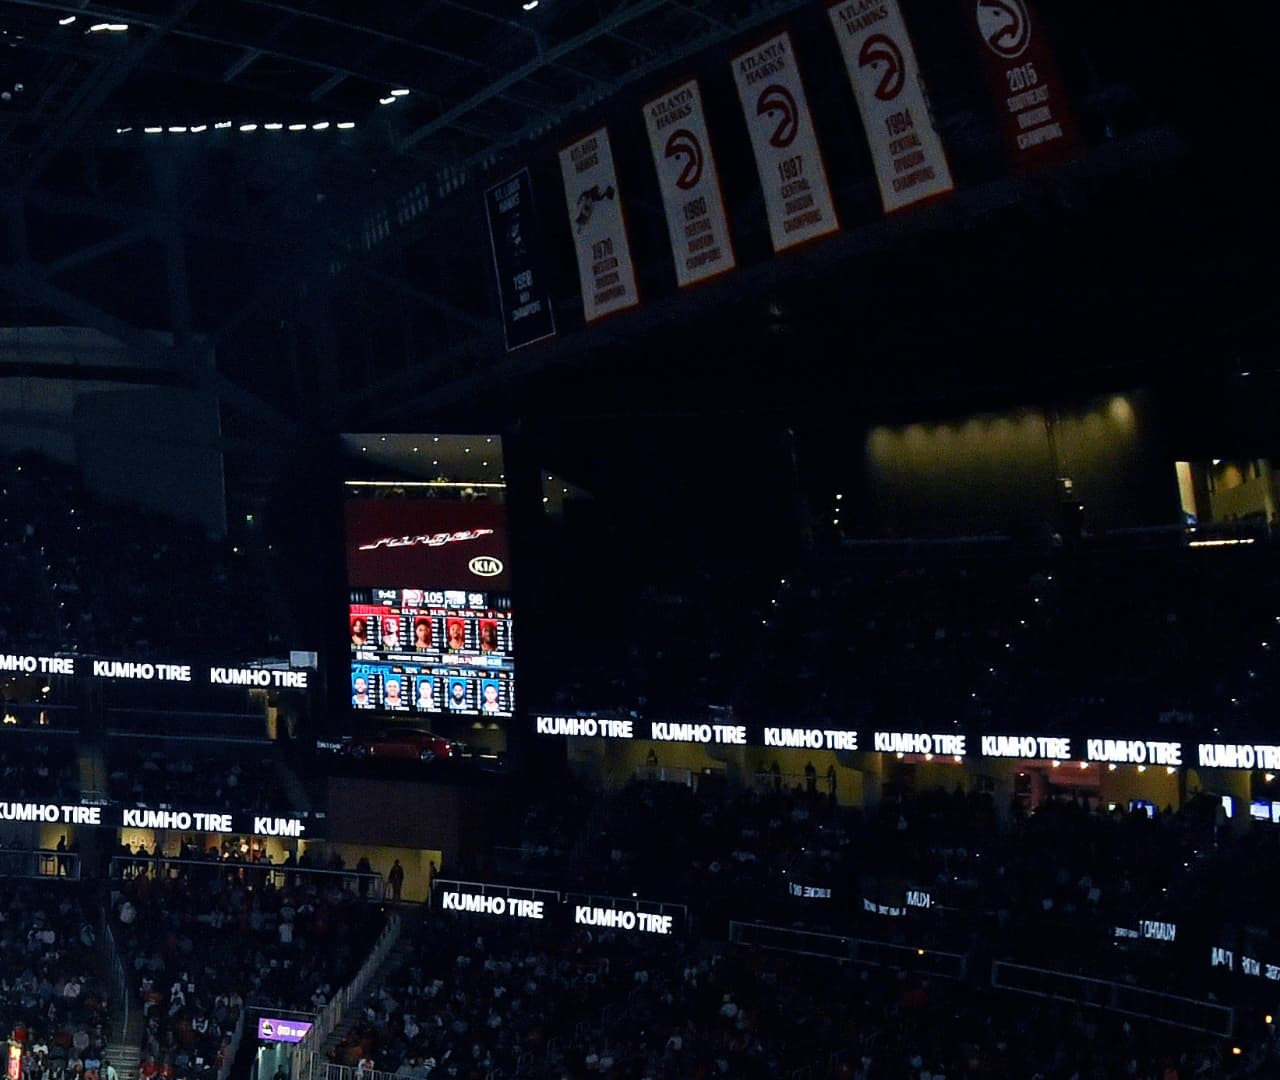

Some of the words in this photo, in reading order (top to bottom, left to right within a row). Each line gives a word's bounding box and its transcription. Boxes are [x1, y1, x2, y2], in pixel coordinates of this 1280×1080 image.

[846, 6, 889, 35] HAWKS
[740, 42, 786, 75] ATLANTA
[746, 57, 785, 86] HAWKS
[1006, 62, 1038, 92] 2015
[651, 88, 693, 118] ATLANTA
[656, 104, 693, 130] HAWKS
[474, 560, 497, 573] KIA
[424, 592, 443, 603] 105
[468, 594, 483, 605] 98
[38, 657, 73, 674] TIRE
[94, 661, 154, 679] KUMHO
[156, 665, 191, 681] TIRE
[211, 667, 272, 685] KUMHO
[271, 669, 307, 687] TIRE
[537, 717, 597, 736] KUMHO
[598, 720, 633, 737] TIRE
[652, 722, 711, 742] KUMHO
[713, 725, 746, 744] TIRE
[875, 732, 933, 753] KUMHO
[932, 735, 966, 755] TIRE
[1087, 739, 1147, 762] KUMHO
[1146, 742, 1182, 765] TIRE
[1199, 744, 1256, 768] KUMHO
[1255, 746, 1280, 769] TIR
